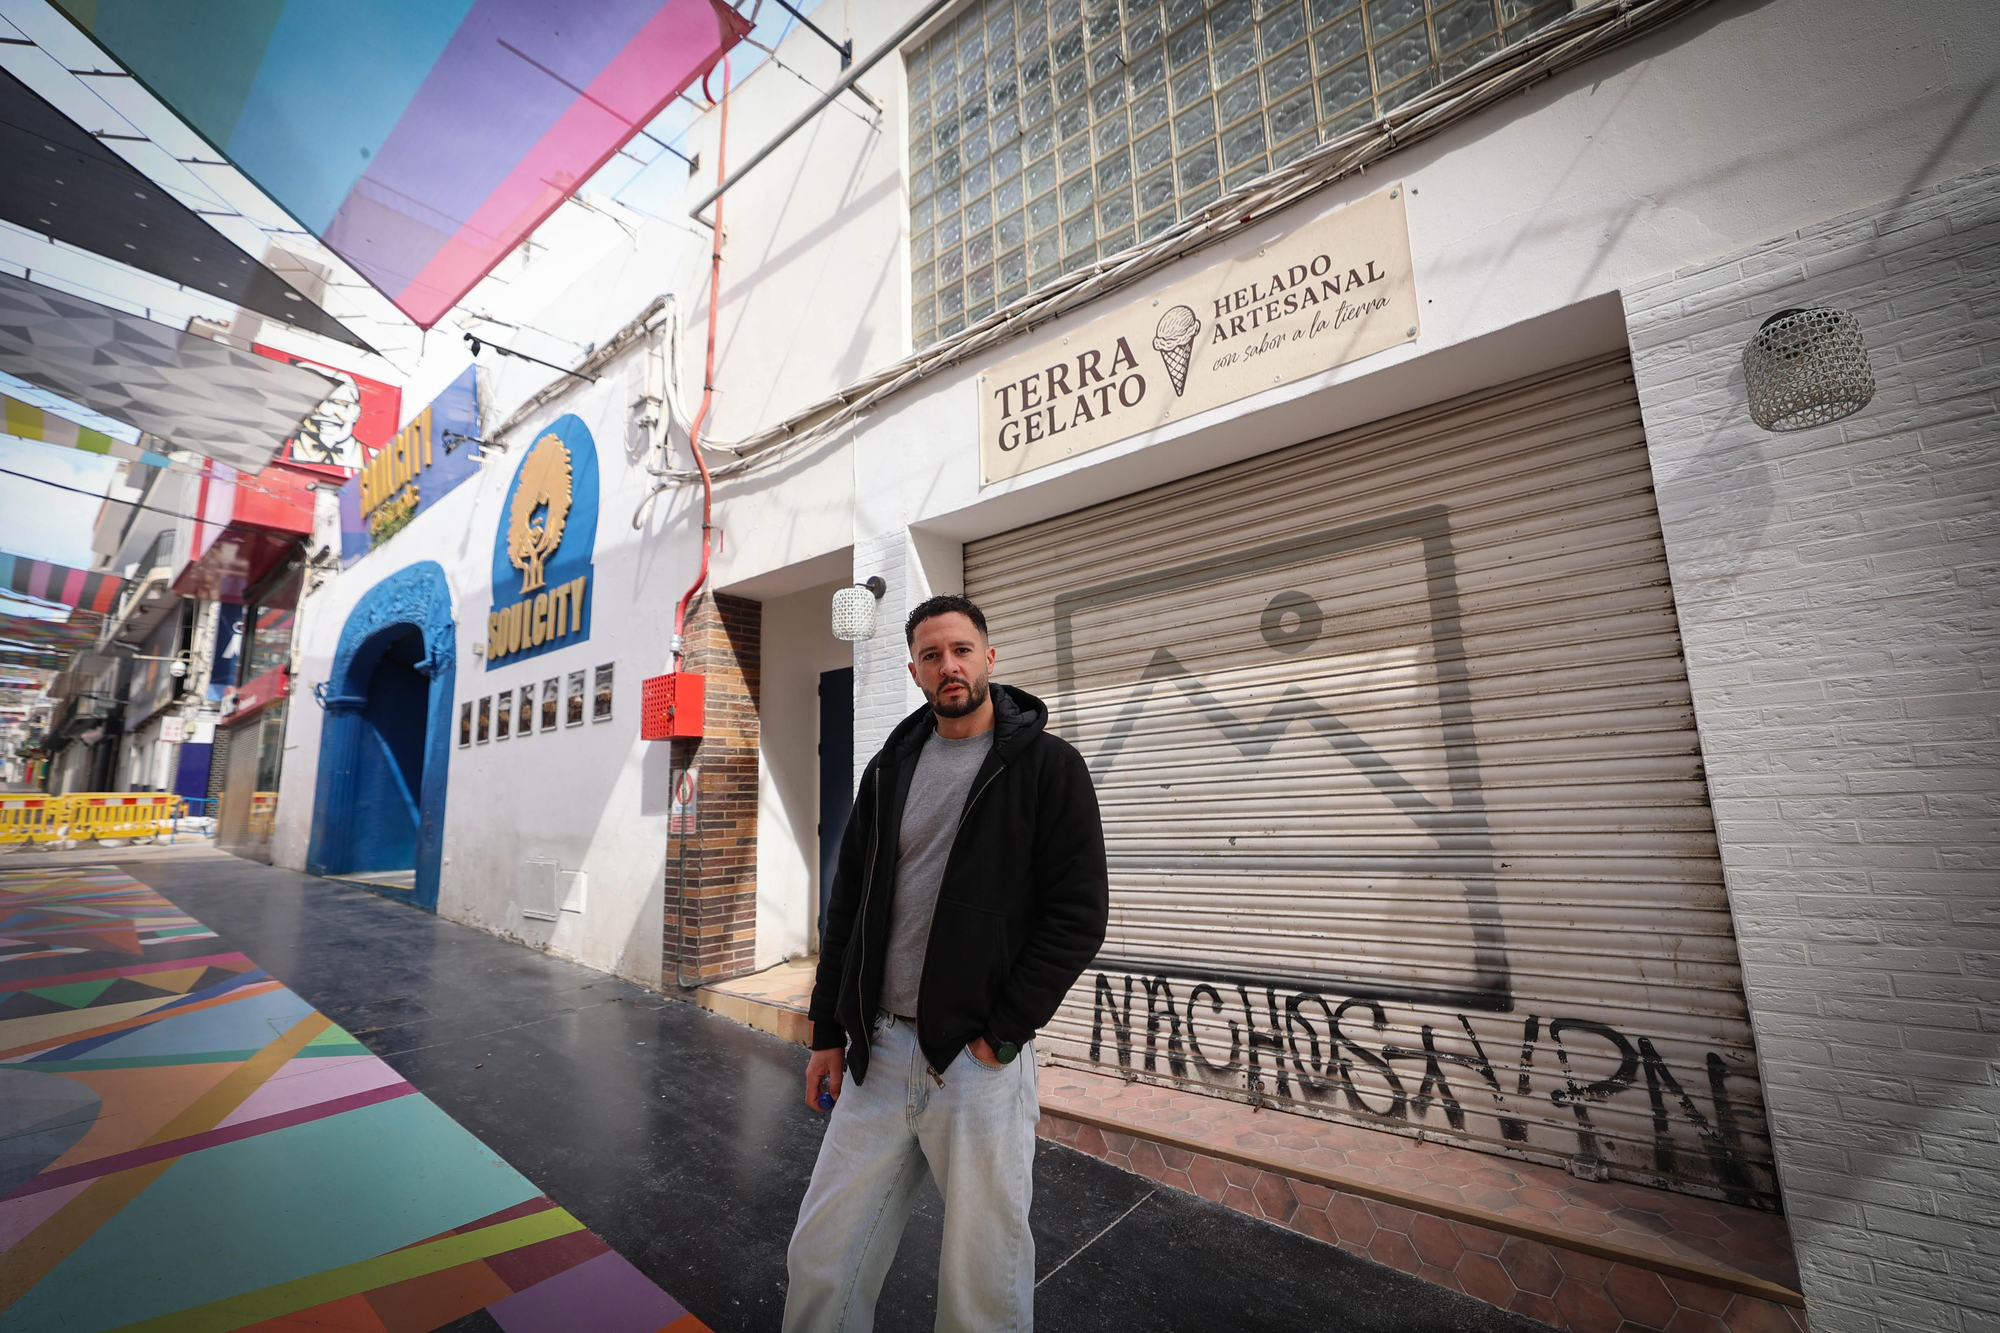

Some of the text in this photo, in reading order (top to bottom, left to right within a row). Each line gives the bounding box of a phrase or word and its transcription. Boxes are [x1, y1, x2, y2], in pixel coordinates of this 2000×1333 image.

[1212, 260, 1385, 345] ARTESANAL
[1213, 254, 1332, 319] HELADO
[1212, 296, 1391, 372] con sabor a la tierra
[994, 335, 1140, 420] TERRA
[998, 373, 1147, 452] GELATO
[487, 575, 586, 661] SOULCITY
